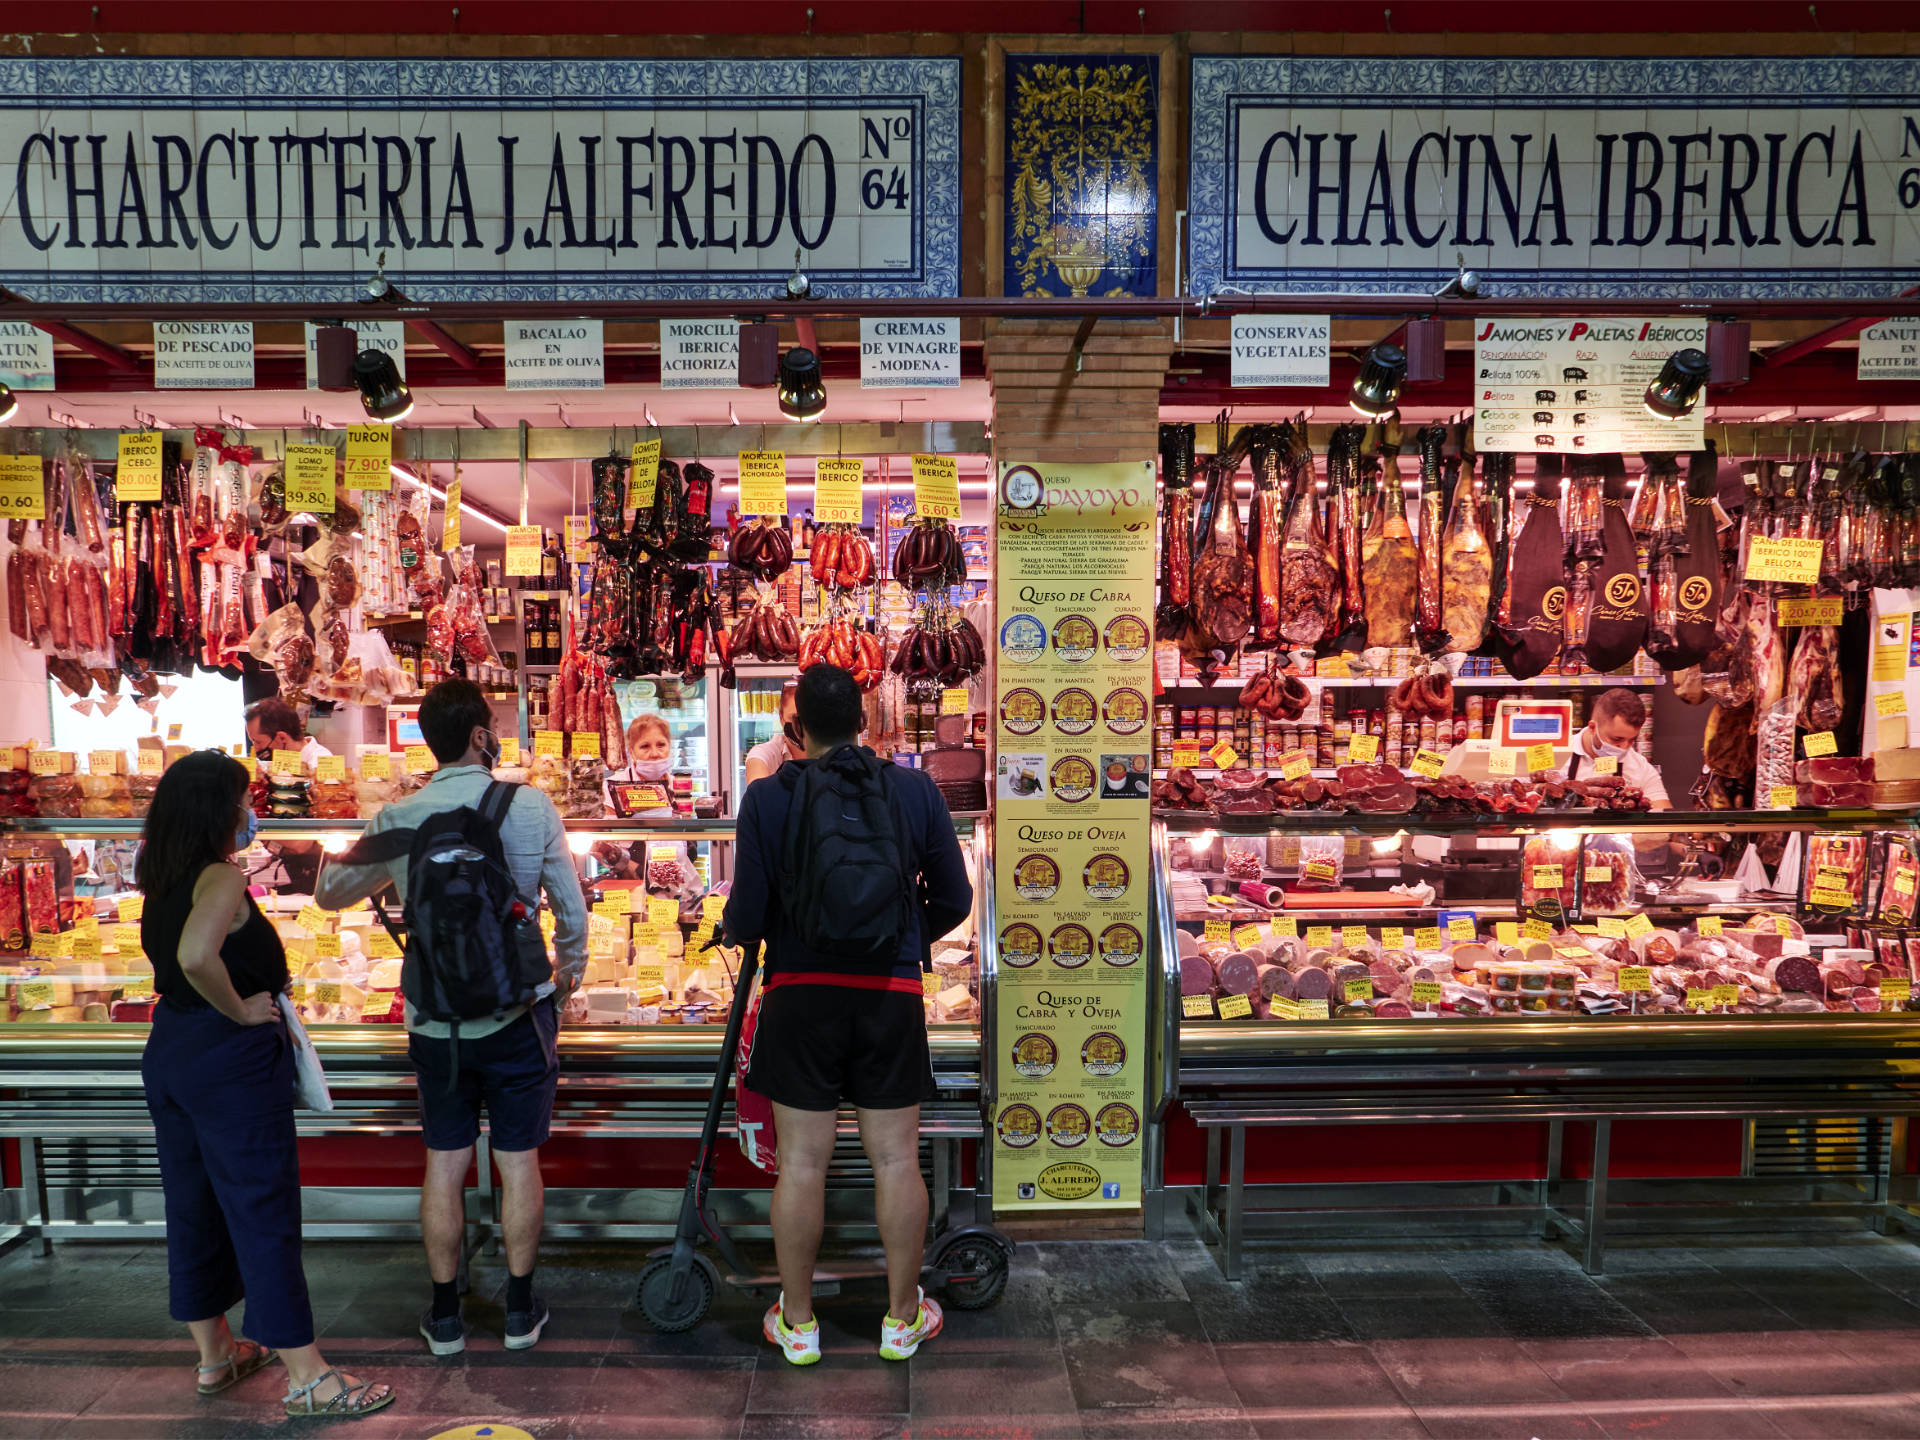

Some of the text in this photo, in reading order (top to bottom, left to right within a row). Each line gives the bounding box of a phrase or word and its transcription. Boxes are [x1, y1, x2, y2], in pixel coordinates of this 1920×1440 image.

[17, 127, 836, 257] CHARCUTERIA J.ALFREDO
[861, 165, 908, 210] 64
[1254, 125, 1876, 255] CHACINA IBERICA
[159, 322, 250, 335] CONSERVAS
[519, 328, 587, 340] BACALAO
[669, 324, 739, 337] MORCILL
[874, 322, 946, 336] CREMAS
[1234, 327, 1327, 339] CONSERVAS
[1478, 322, 1705, 341] JAMONES Y PALETAS IBÉRICOS
[158, 341, 252, 353] DE PESCADO
[545, 344, 561, 354] EN
[679, 342, 739, 354] IBERICA
[862, 341, 959, 355] DE VINAGRE
[1235, 346, 1327, 358] VEGETALES
[1901, 345, 1916, 353] EN
[157, 360, 252, 369] EN ACEITE DE OLIVA
[507, 357, 601, 368] ACEITE DE OLIVA
[663, 359, 738, 371] ACHORIZA
[880, 359, 941, 371] MODENA
[1860, 357, 1902, 367] ACEITE
[1480, 369, 1541, 379] Bellota 100%
[1483, 391, 1516, 401] Bellota
[128, 435, 153, 444] LOMO
[348, 432, 389, 443] TURON
[123, 446, 157, 455] IBERICO
[324, 448, 335, 456] DE
[348, 458, 380, 472] 7.90
[746, 462, 780, 470] IBERICA
[818, 462, 861, 470] CHORIZO
[915, 457, 956, 469] MORCILLA
[639, 468, 649, 477] DE
[819, 473, 859, 482] IBERICO
[919, 468, 953, 478] IBERICA
[1045, 476, 1071, 484] QUESO
[286, 491, 326, 504] 39.80
[745, 501, 775, 513] 8.95
[922, 503, 949, 517] 6.60
[818, 509, 847, 520] 8.90
[510, 526, 539, 534] JAMON
[1781, 539, 1793, 547] DE
[1794, 541, 1823, 550] LOMO
[1754, 548, 1790, 557] IBERICO
[1764, 559, 1802, 568] BELLOTA
[1019, 585, 1131, 604] QUESO DE CABRA
[1018, 825, 1127, 843] QUESO DE OVEJA
[1037, 990, 1102, 1009] QUESO DE
[1016, 1005, 1122, 1019] CABRA Y OVEJA
[1051, 1175, 1099, 1184] ALFREDO
